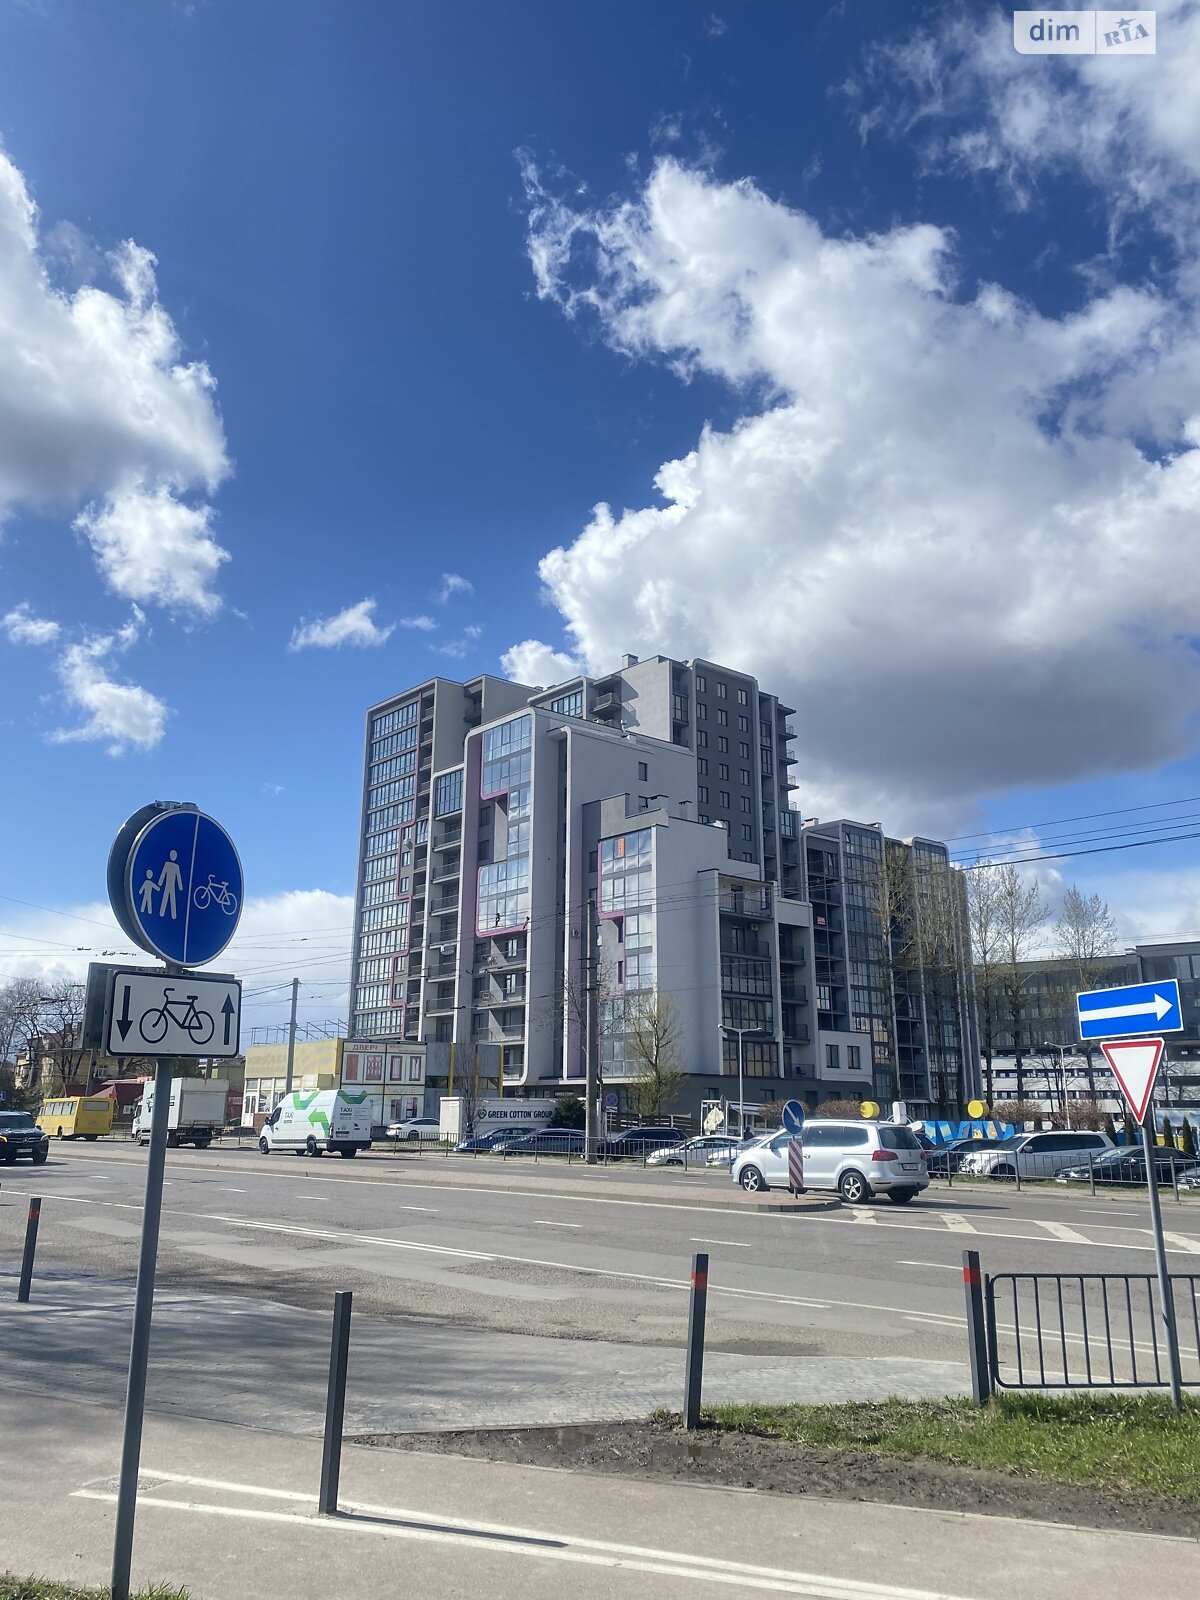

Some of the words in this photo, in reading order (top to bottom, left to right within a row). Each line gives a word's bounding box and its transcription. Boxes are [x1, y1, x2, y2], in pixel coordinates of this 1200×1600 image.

[487, 1110, 508, 1119] GREEN
[509, 1110, 532, 1119] COTTON
[533, 1110, 553, 1119] GROUP
